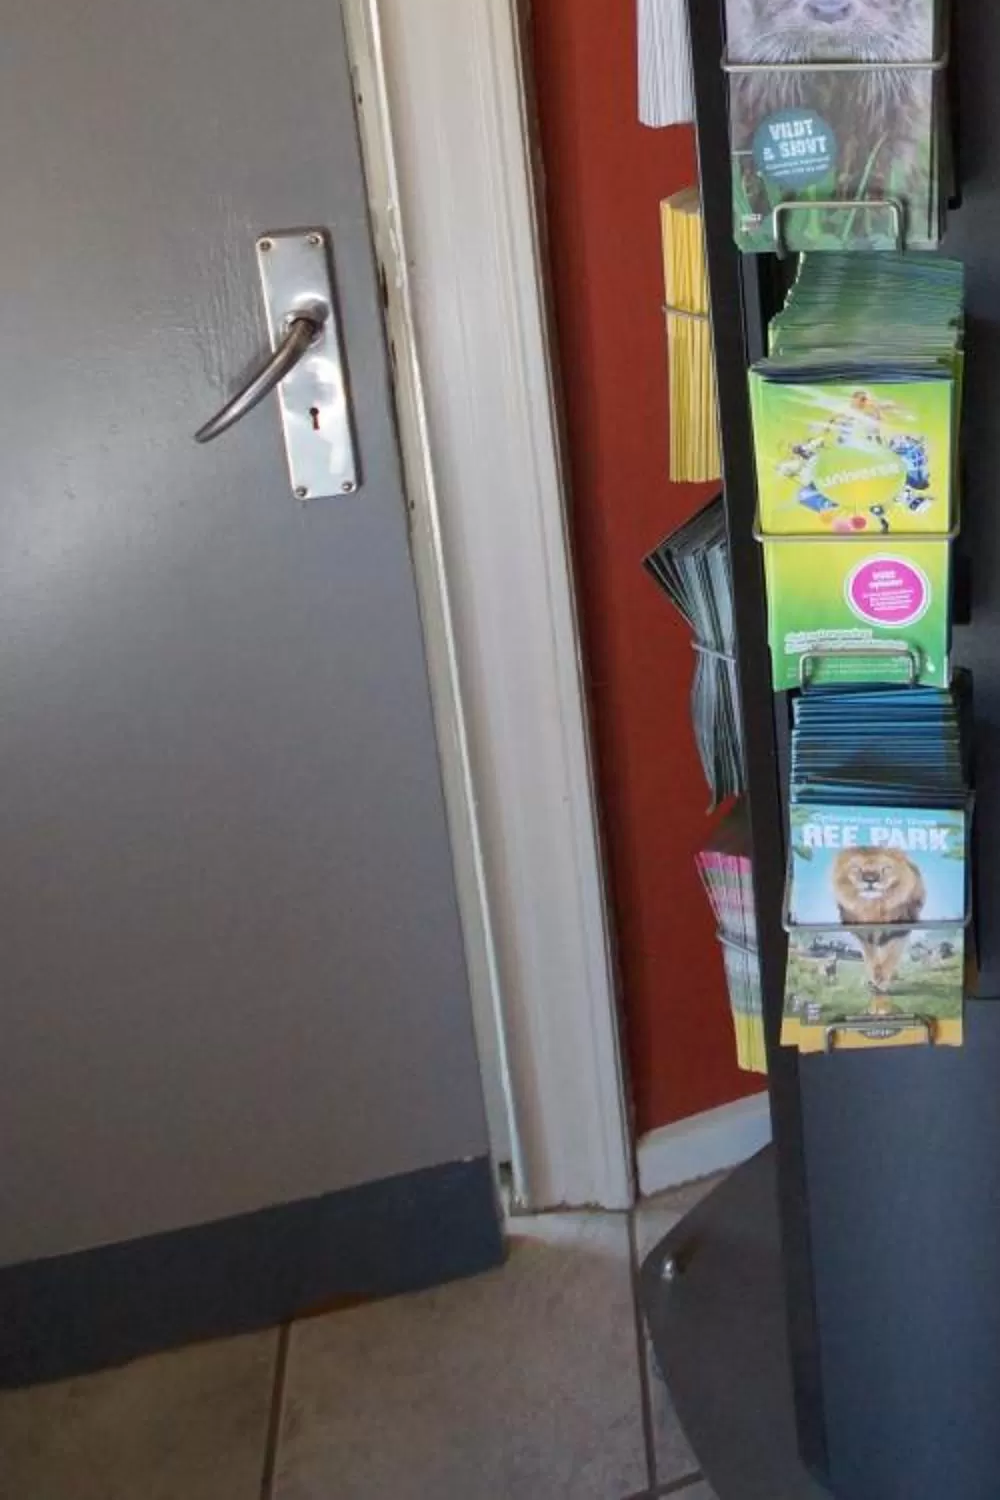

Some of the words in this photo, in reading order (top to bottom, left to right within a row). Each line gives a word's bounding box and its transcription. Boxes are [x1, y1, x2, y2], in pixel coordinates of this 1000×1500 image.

[768, 117, 814, 141] VILDT
[778, 134, 828, 160] SJOVT
[802, 822, 858, 849] REE
[869, 826, 948, 851] PARK
